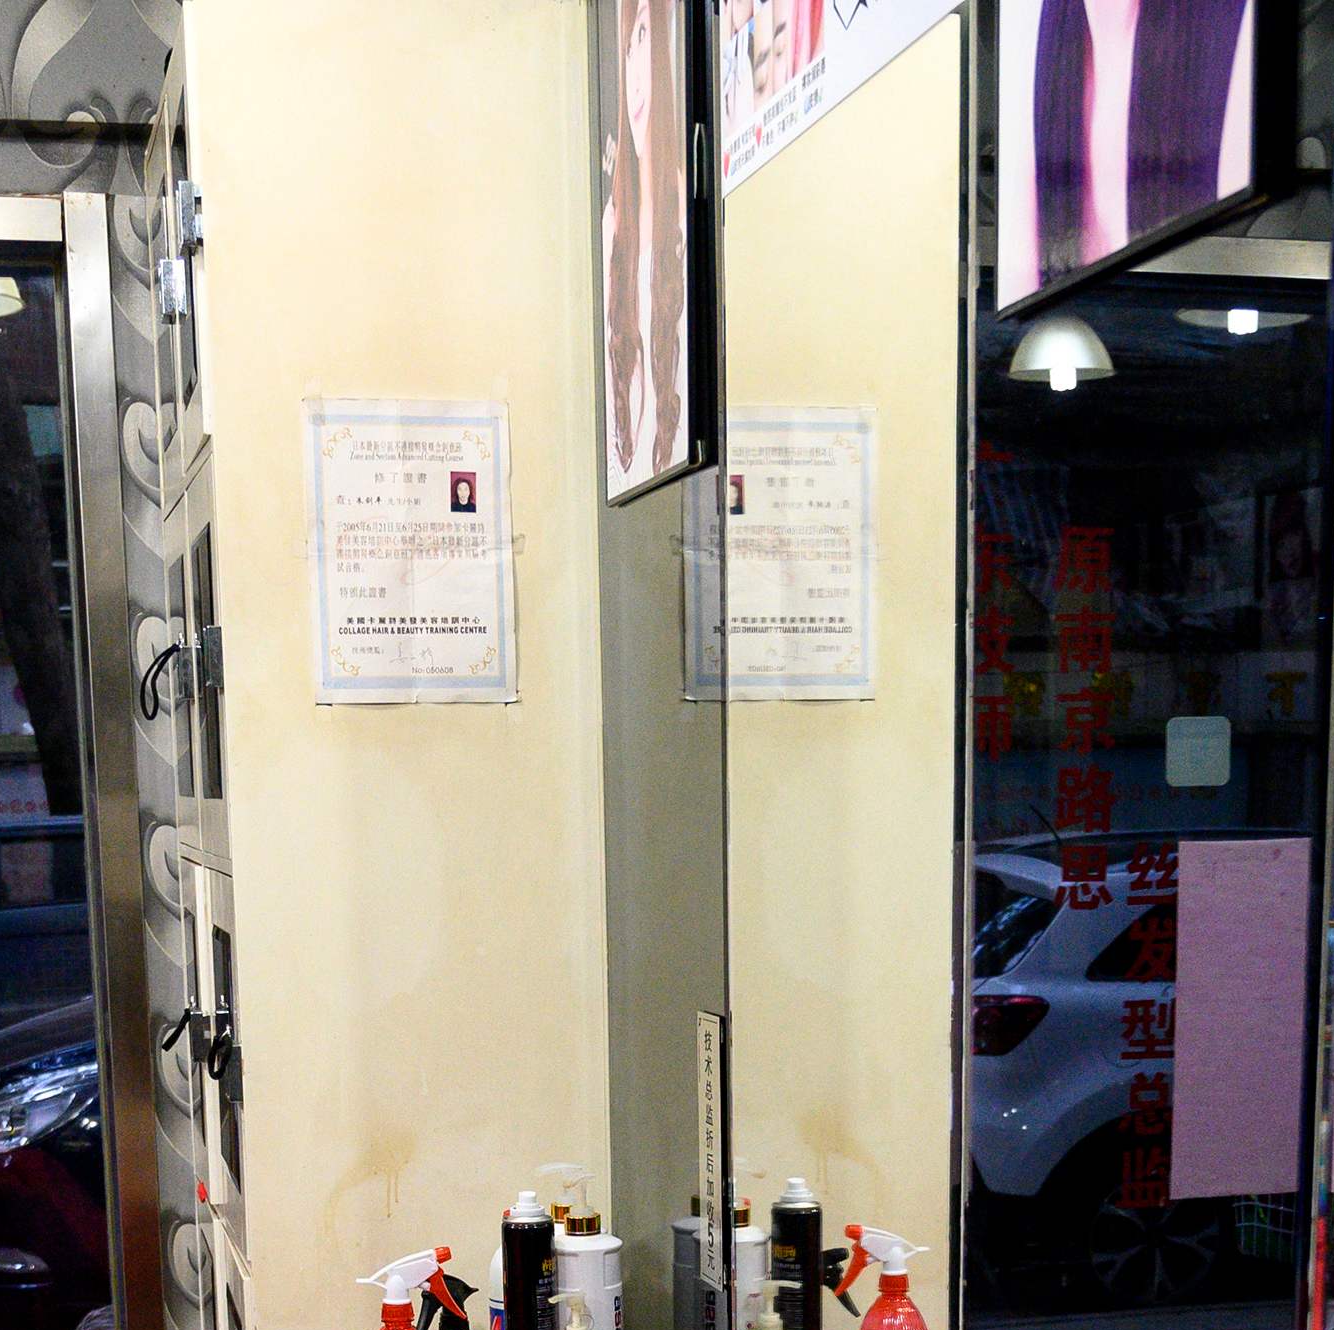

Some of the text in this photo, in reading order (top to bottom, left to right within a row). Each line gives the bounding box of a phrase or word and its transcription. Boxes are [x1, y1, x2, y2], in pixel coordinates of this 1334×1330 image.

[339, 626, 370, 635] COLLAGE
[372, 626, 389, 635] HAIR
[397, 626, 423, 635] BEAUTY
[425, 626, 459, 635] TRAINING
[460, 626, 487, 635] CENTRE
[1050, 522, 1116, 910] 原南京路思
[1116, 842, 1178, 1209] 丝发型总监
